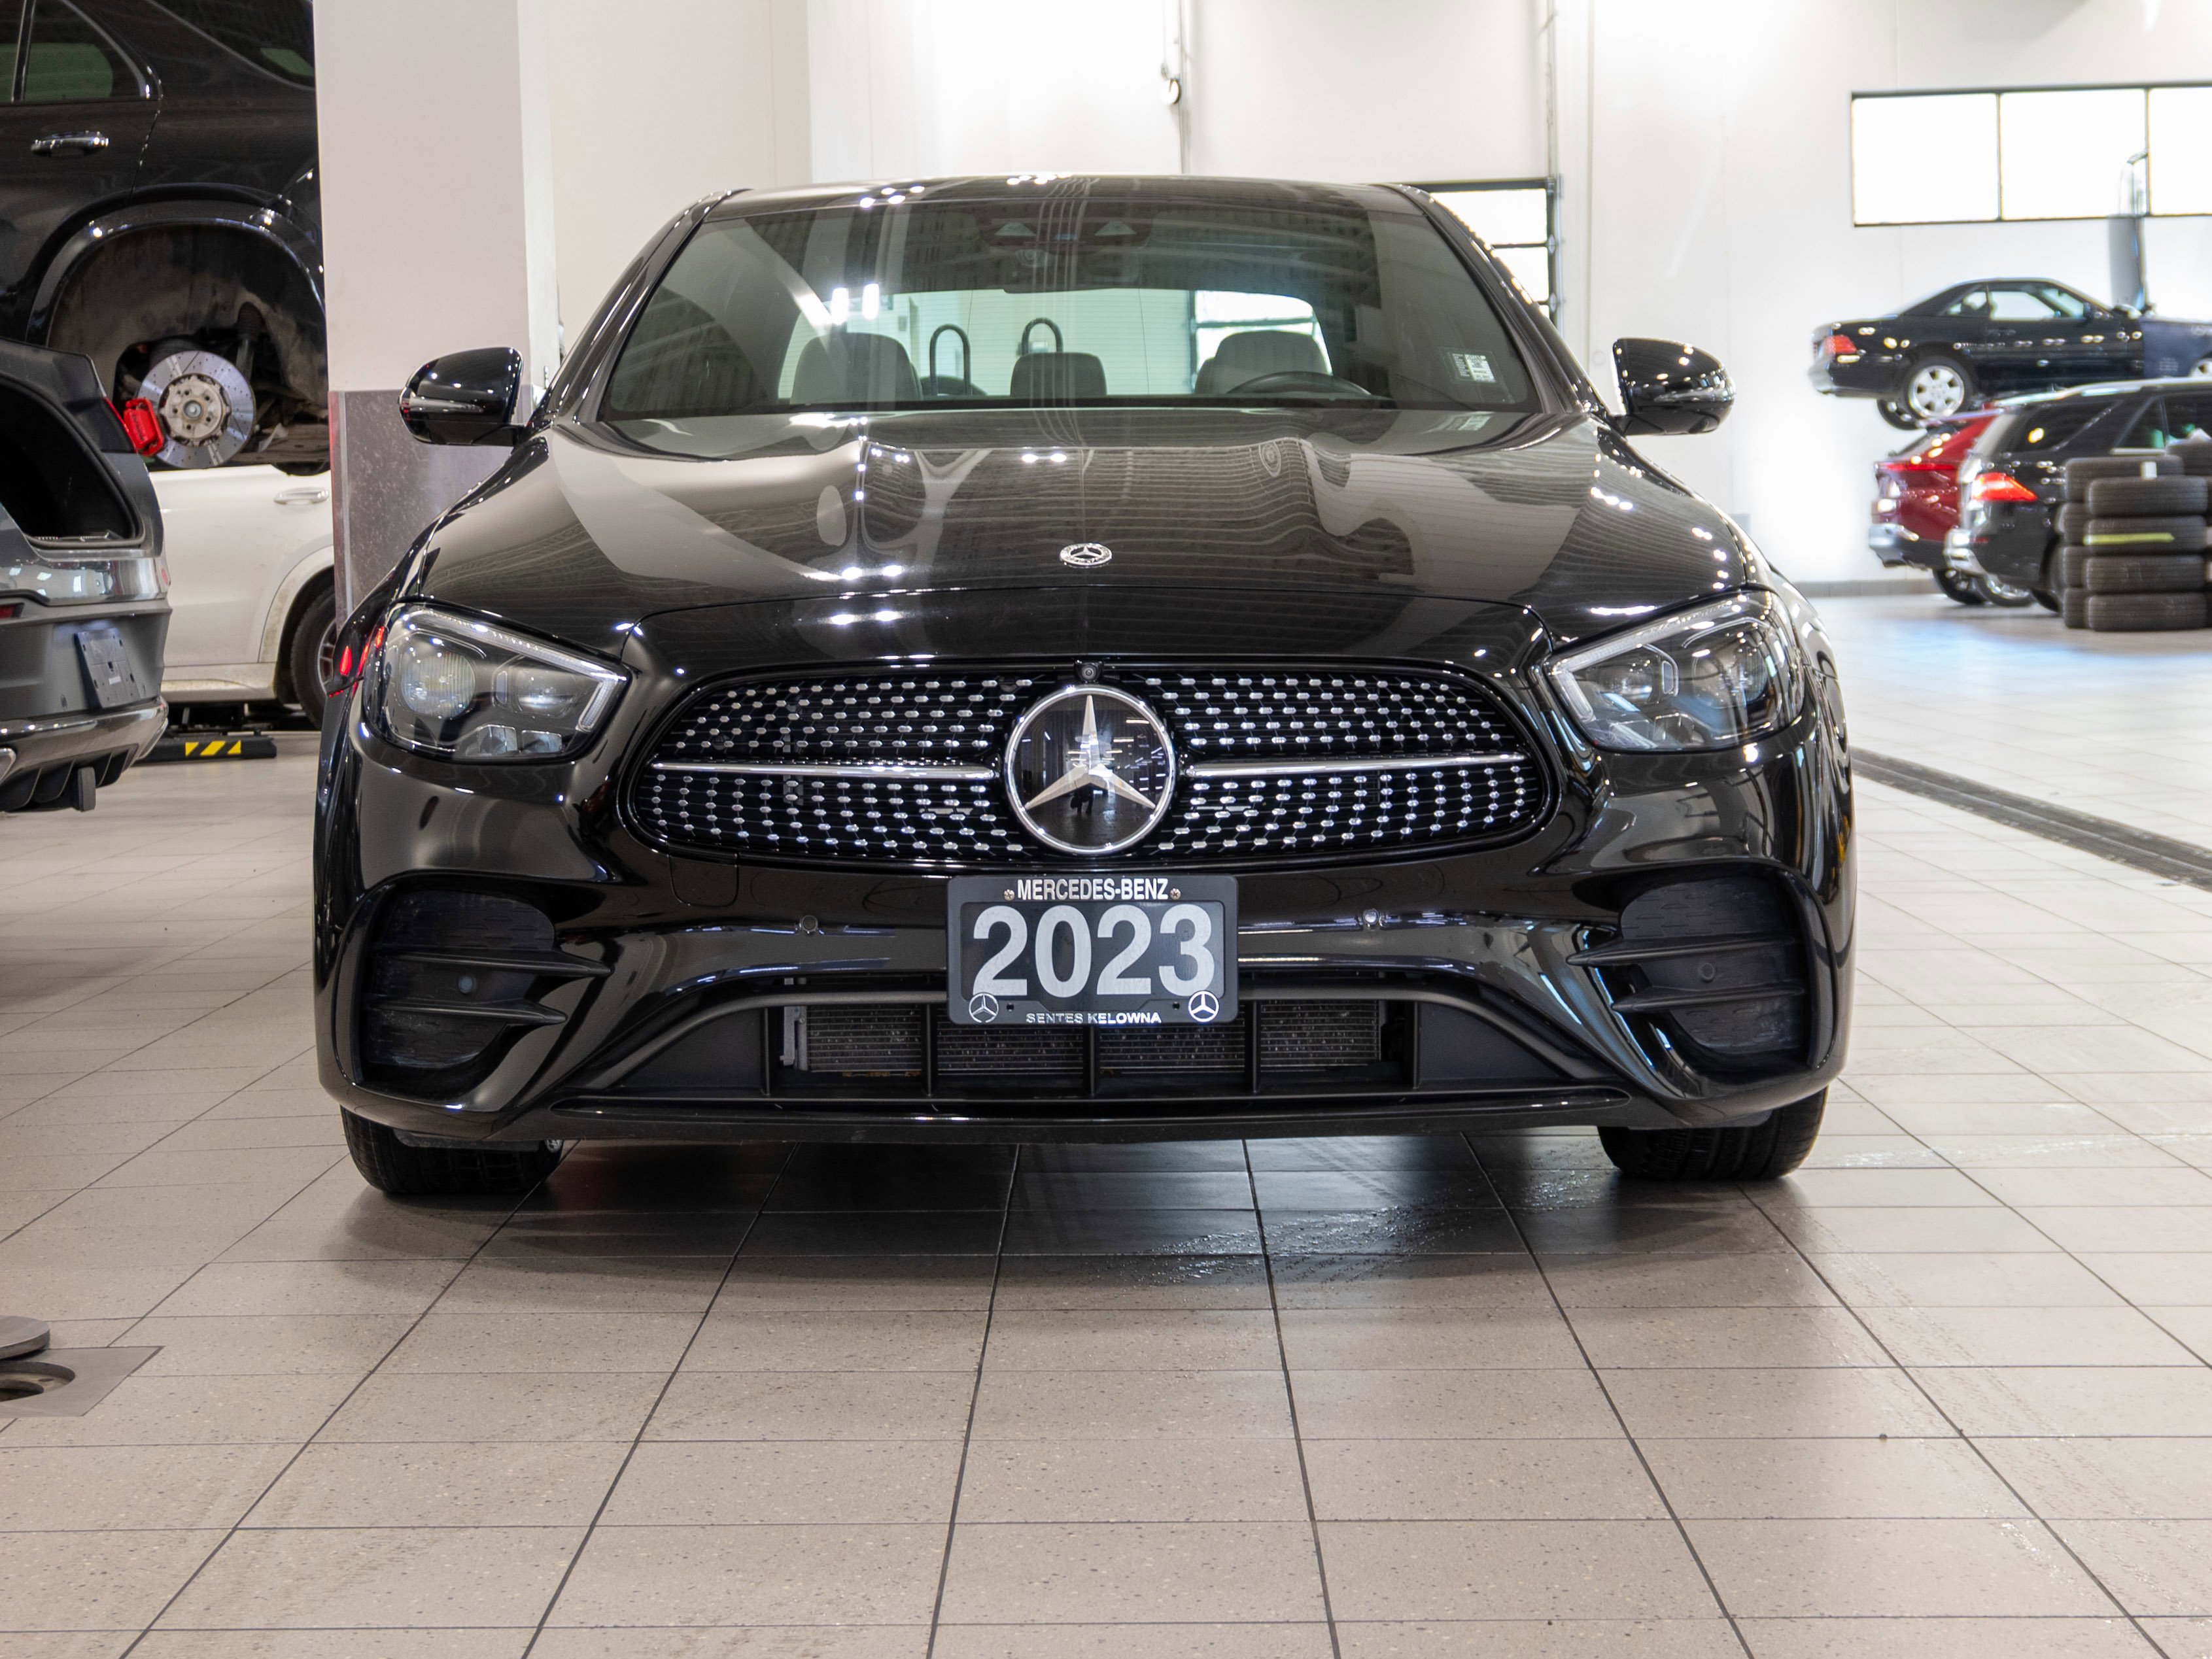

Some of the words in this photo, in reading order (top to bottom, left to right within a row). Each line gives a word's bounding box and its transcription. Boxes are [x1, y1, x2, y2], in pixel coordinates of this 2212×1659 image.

[1017, 878, 1168, 900] MERCEDES-BENZ
[973, 904, 1215, 998] 2023
[1026, 1013, 1083, 1024] SENTES
[1088, 1012, 1162, 1024] KELOWNA
